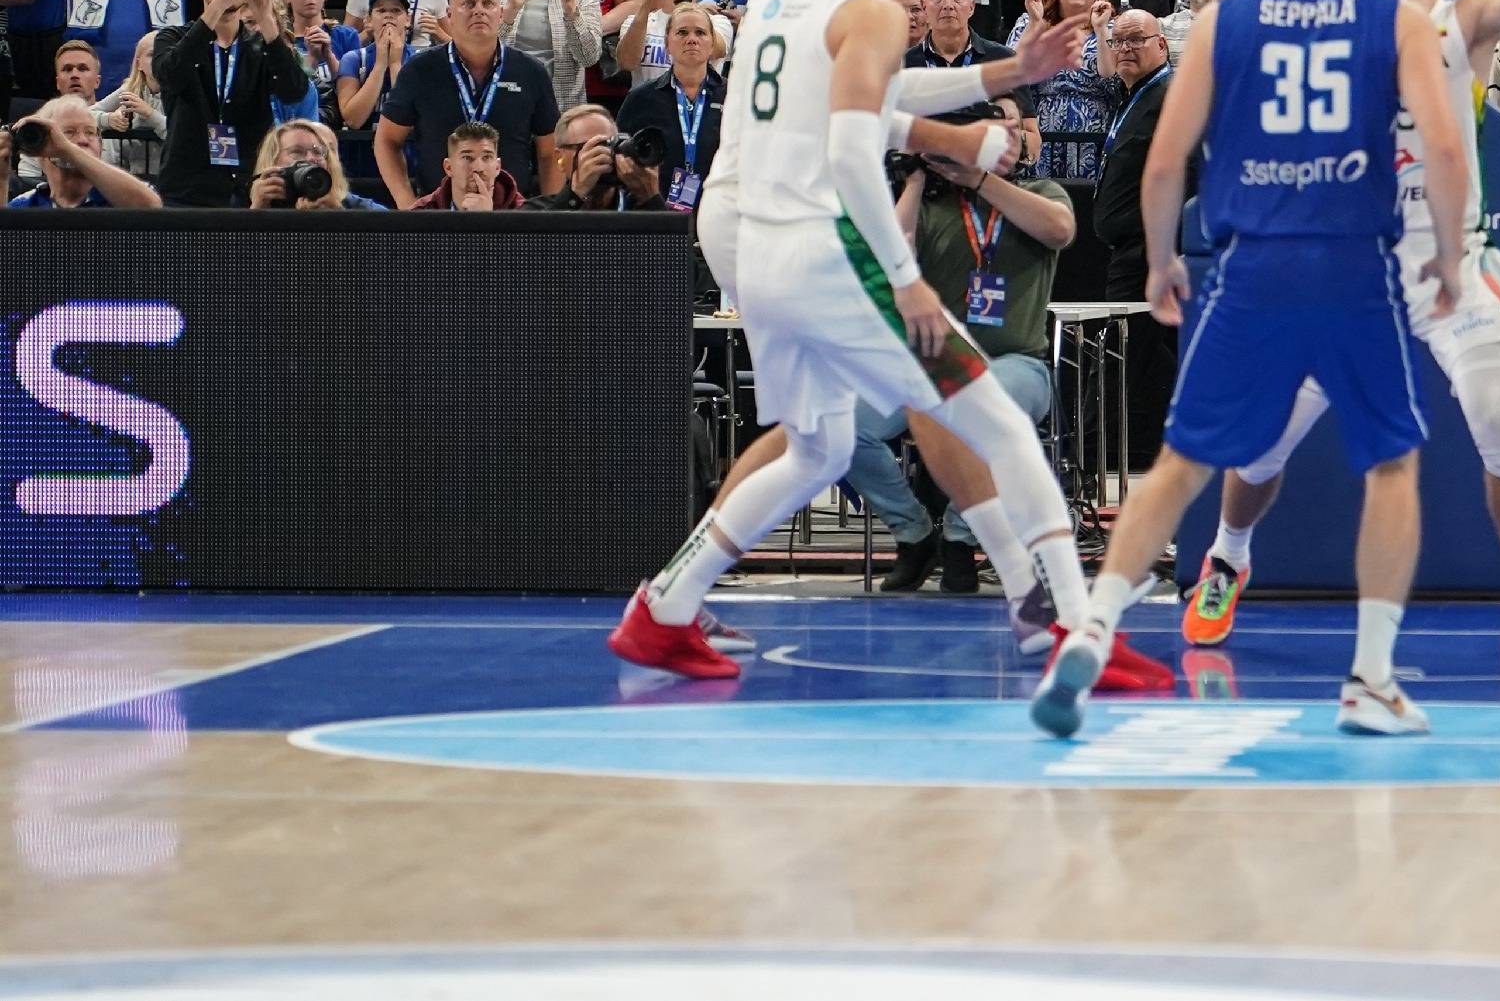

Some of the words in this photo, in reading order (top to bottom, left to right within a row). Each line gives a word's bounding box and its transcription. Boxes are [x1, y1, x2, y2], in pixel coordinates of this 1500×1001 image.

[751, 35, 787, 121] 8
[1260, 38, 1352, 134] 35
[1240, 157, 1338, 191] 3stepIT
[13, 301, 191, 516] S
